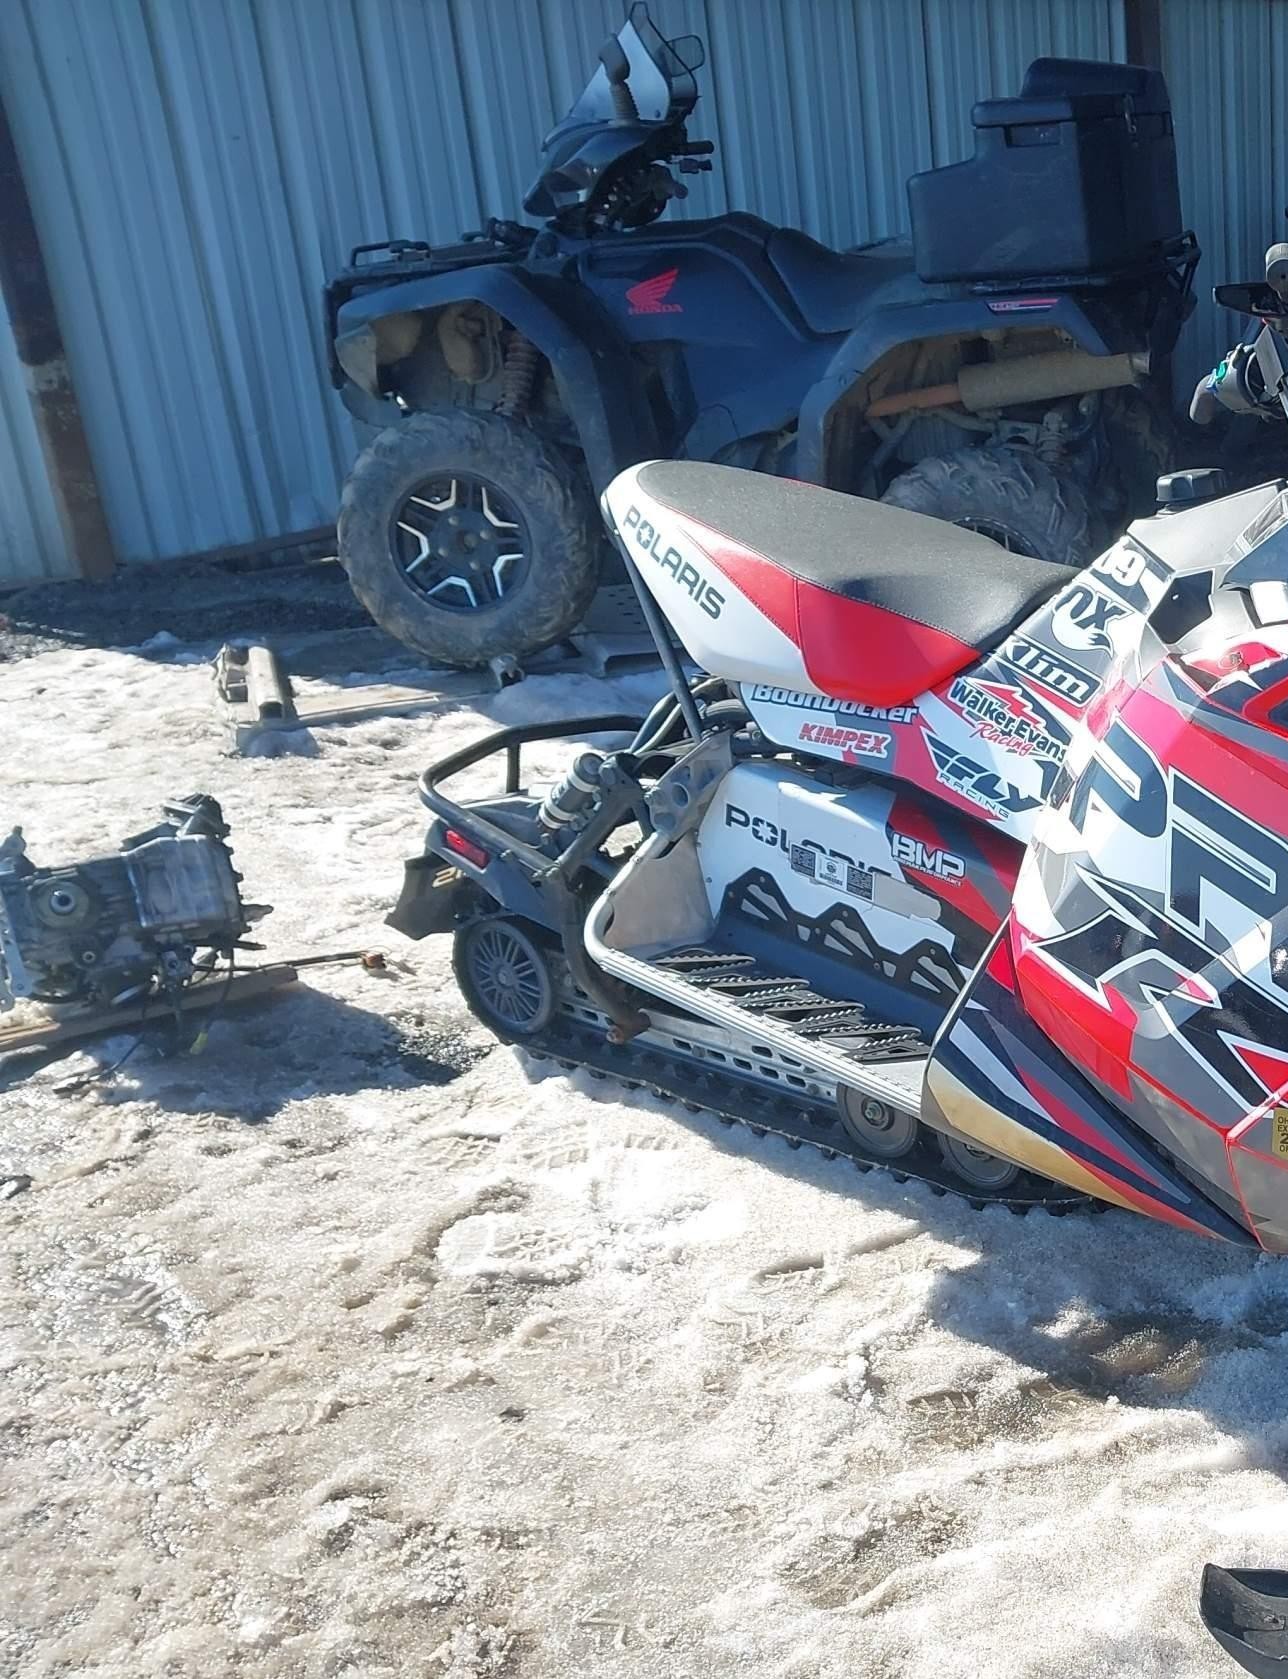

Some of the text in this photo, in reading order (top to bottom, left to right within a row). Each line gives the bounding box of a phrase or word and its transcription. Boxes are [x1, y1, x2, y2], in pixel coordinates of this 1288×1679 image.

[628, 303, 684, 315] HONDA
[623, 505, 726, 620] POLARIS
[799, 722, 889, 755] KIMPEX
[969, 722, 1037, 757] Racing
[926, 732, 1044, 813] FLY
[939, 773, 1010, 818] RACING
[891, 832, 966, 879] BMP
